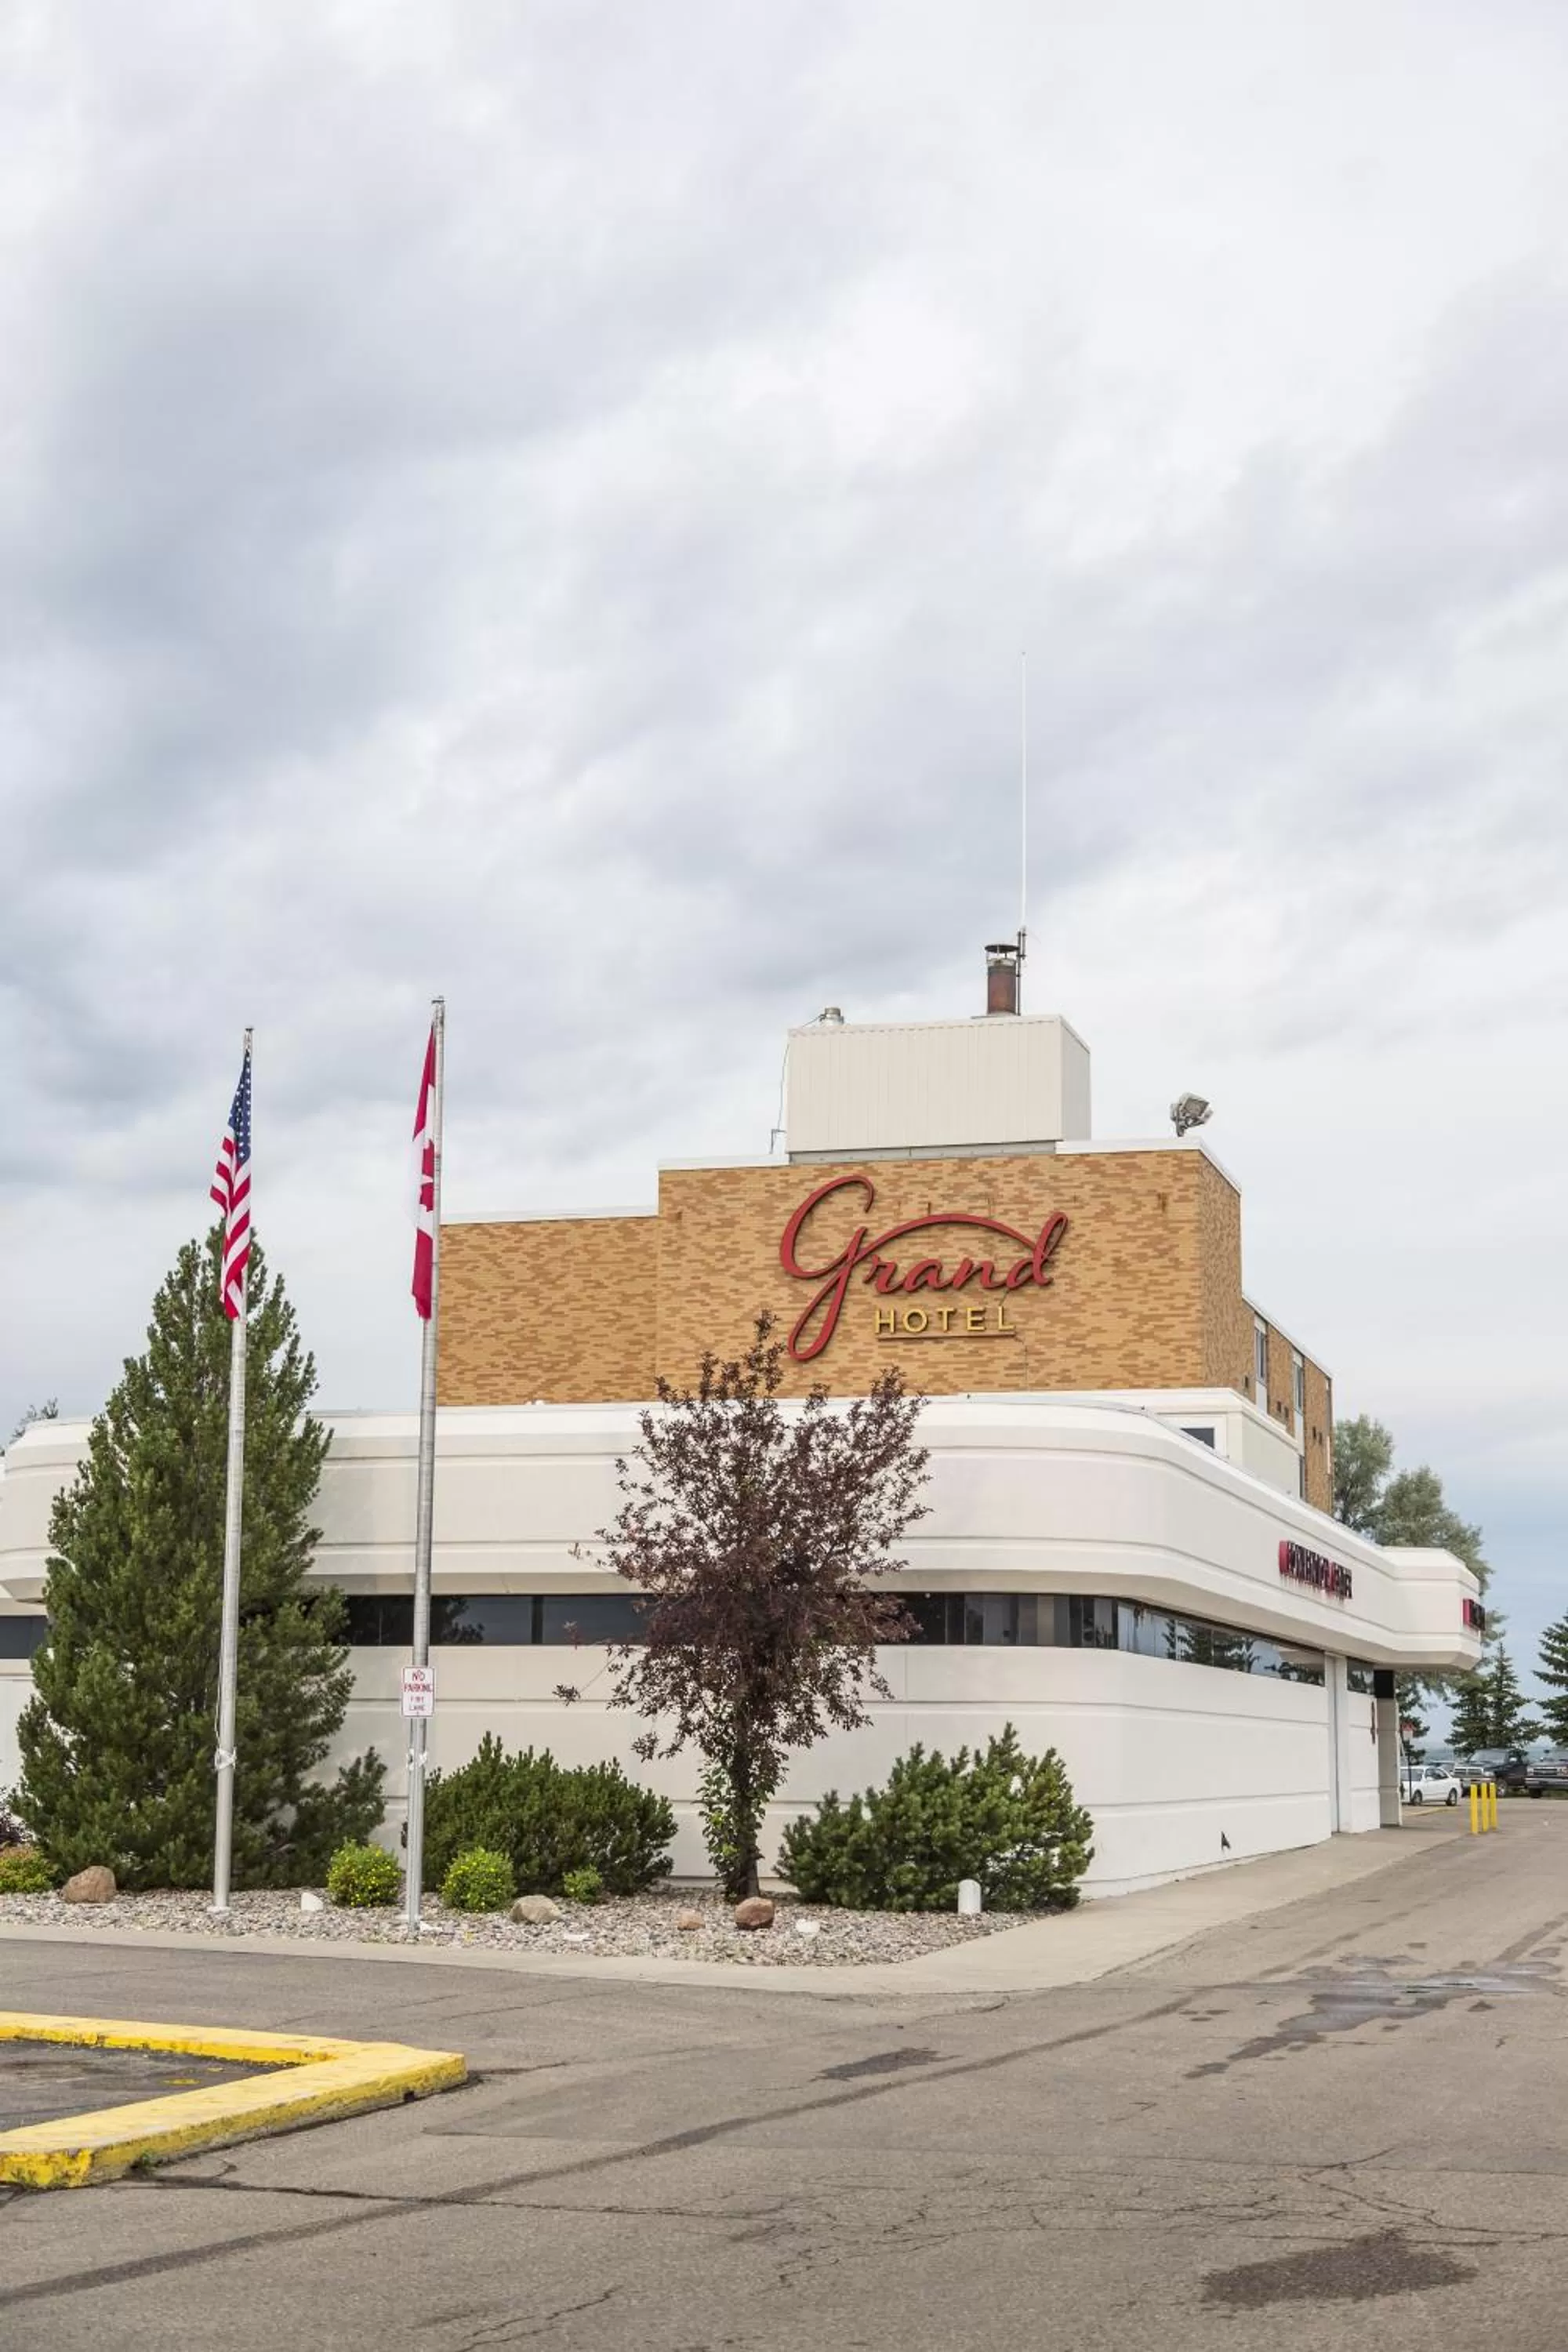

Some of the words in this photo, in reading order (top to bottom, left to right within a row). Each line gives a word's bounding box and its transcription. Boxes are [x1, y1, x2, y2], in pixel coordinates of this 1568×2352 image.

[779, 1175, 1069, 1362] Grand
[874, 1305, 1016, 1334] HOTEL
[412, 1669, 425, 1681] NO
